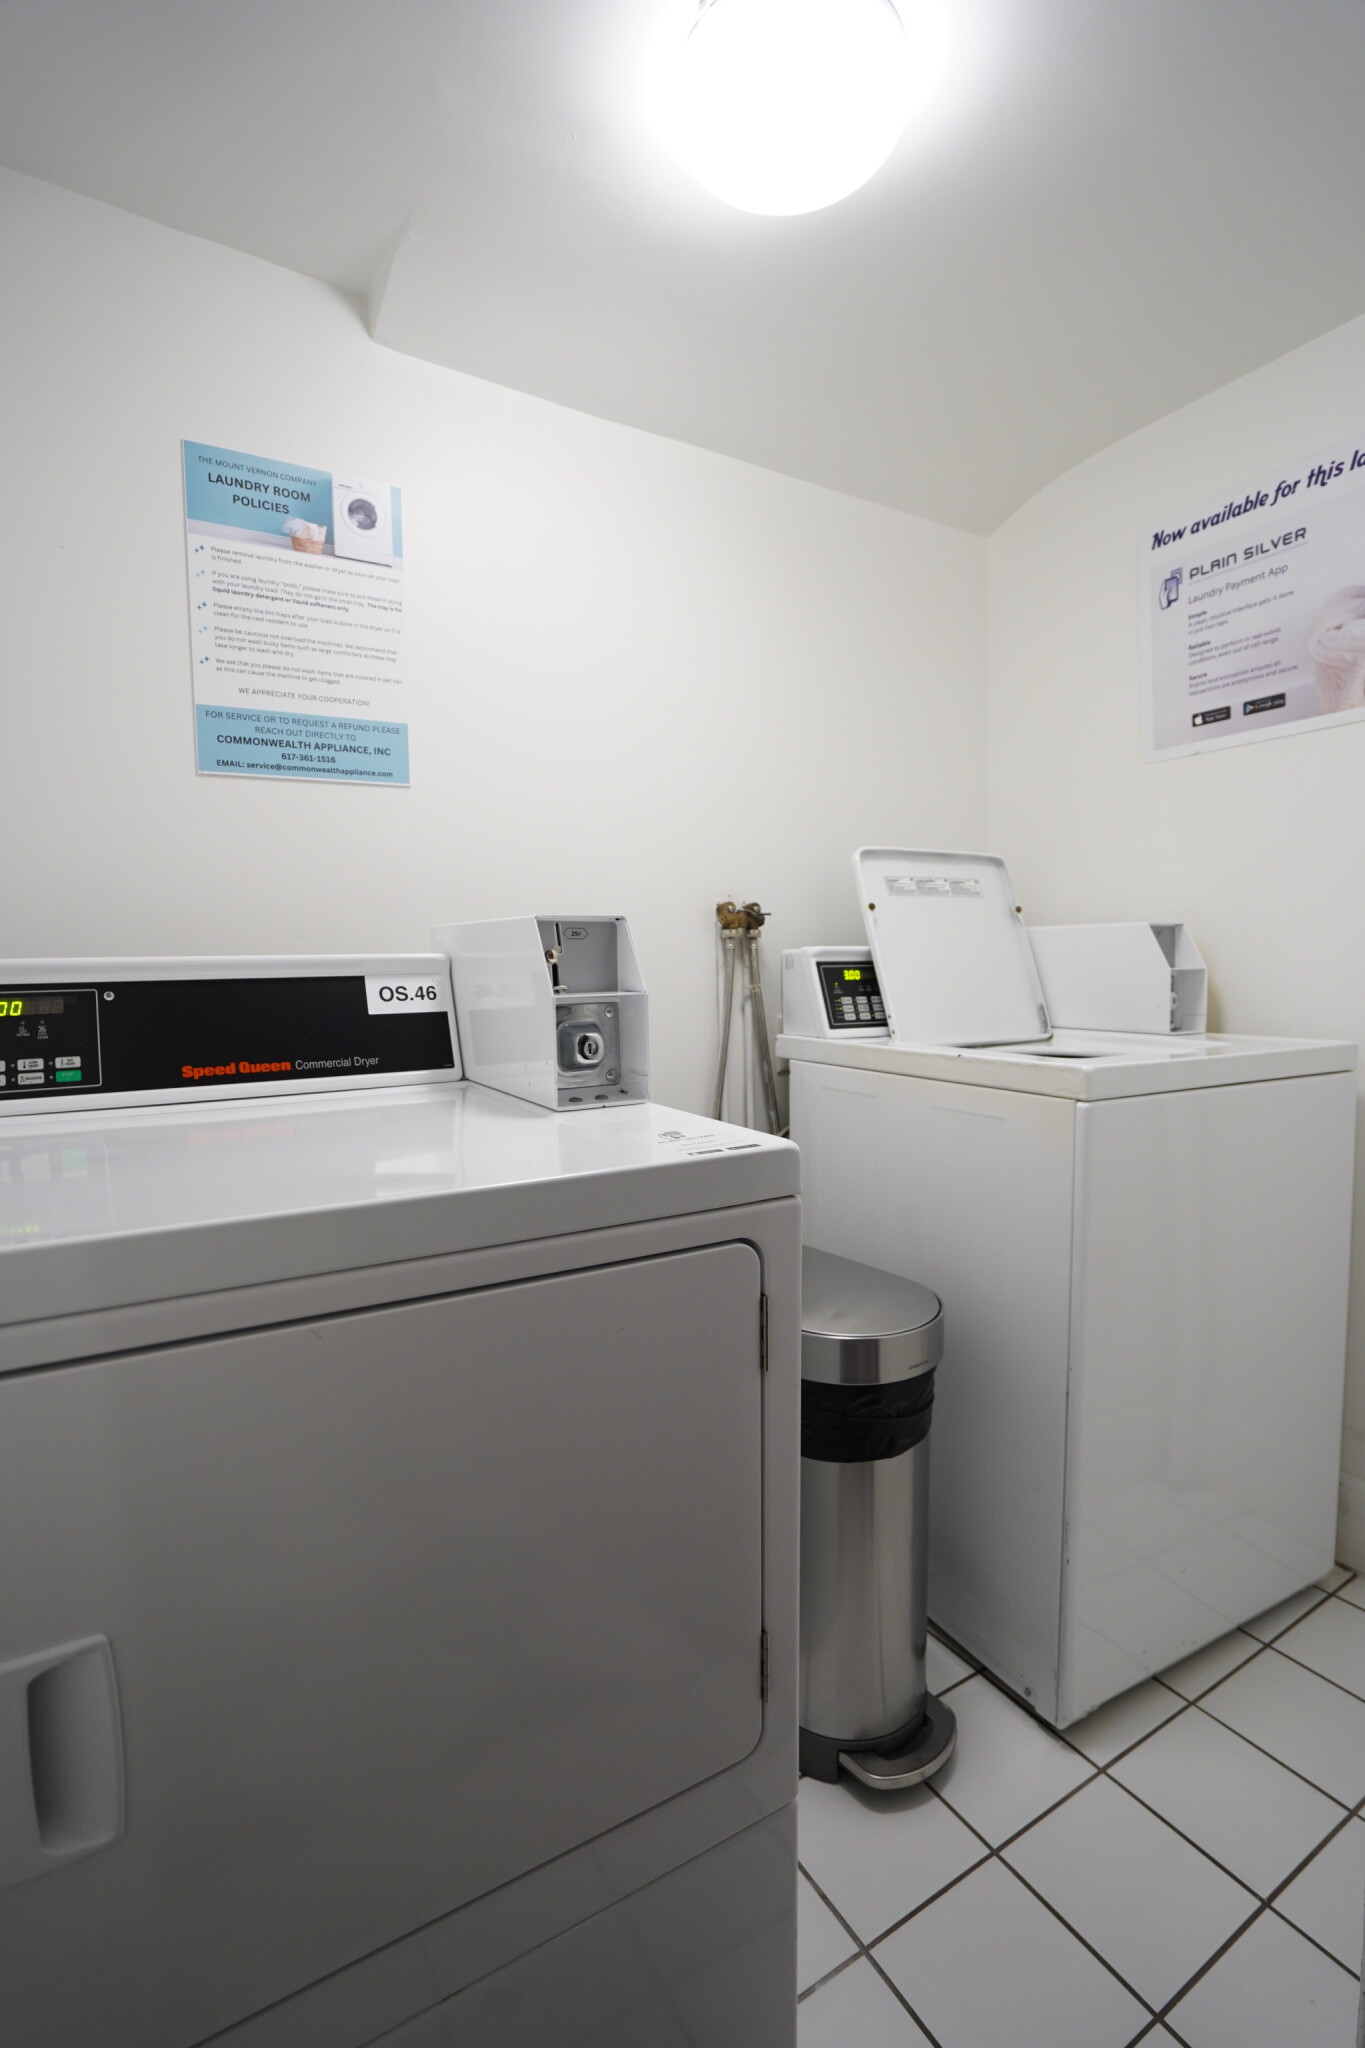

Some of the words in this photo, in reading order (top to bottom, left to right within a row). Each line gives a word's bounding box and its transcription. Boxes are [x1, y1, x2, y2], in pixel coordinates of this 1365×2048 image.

[198, 455, 213, 465] THE
[215, 459, 244, 471] MOUNT
[246, 466, 278, 479] VERNON
[280, 473, 317, 487] COMPANY
[208, 472, 270, 494] LAUNDRY
[273, 486, 311, 502] ROOM
[233, 495, 289, 514] POLICIES
[1152, 526, 1186, 550] Now
[1190, 491, 1269, 534] available
[1270, 480, 1301, 506] for
[1307, 461, 1345, 488] this
[210, 546, 231, 555] Please
[232, 551, 254, 559] remove
[255, 554, 278, 564] laundry
[1190, 553, 1237, 580] PLAIN
[1244, 528, 1307, 560] SILVER
[241, 576, 256, 584] using
[257, 578, 279, 587] laundry
[1188, 587, 1223, 604] Laundry
[1225, 571, 1266, 592] Payment
[1268, 566, 1288, 578] App
[212, 586, 230, 594] liquid
[231, 589, 254, 599] laundry
[255, 593, 284, 602] detergent
[292, 598, 309, 606] liquid
[309, 602, 337, 610] softeners
[241, 583, 264, 593] laundry
[280, 589, 294, 597] They
[377, 603, 388, 611] tray
[213, 602, 233, 610] Please
[233, 606, 253, 614] empty
[276, 611, 290, 619] traps
[266, 618, 290, 626] resident
[264, 641, 279, 649] bulky
[238, 687, 251, 695] WE
[251, 688, 296, 699] APPRECIATE
[297, 693, 317, 701] YOUR
[205, 711, 223, 719] FOR
[225, 712, 261, 722] SERVICE
[263, 716, 276, 724] OR
[278, 717, 289, 725] TO
[291, 718, 329, 728] REQUEST
[338, 722, 370, 732] REFUND
[372, 726, 400, 735] PLEASE
[255, 727, 284, 735] REACH
[286, 729, 303, 737] OUT
[305, 731, 343, 740] DIRECTLY
[217, 735, 311, 750] COMMONWEALTH
[314, 742, 372, 756] APPLIANCE,
[374, 747, 391, 756] INC
[281, 753, 336, 763] 617-361-1516
[216, 760, 245, 768] EMAIL:
[246, 762, 393, 778] service@commonwealthappliance.com
[378, 985, 437, 1003] OS.46
[181, 1062, 237, 1080] Speed
[239, 1060, 292, 1074] Queen
[295, 1057, 352, 1070] Commercial
[354, 1056, 380, 1067] Dryer
